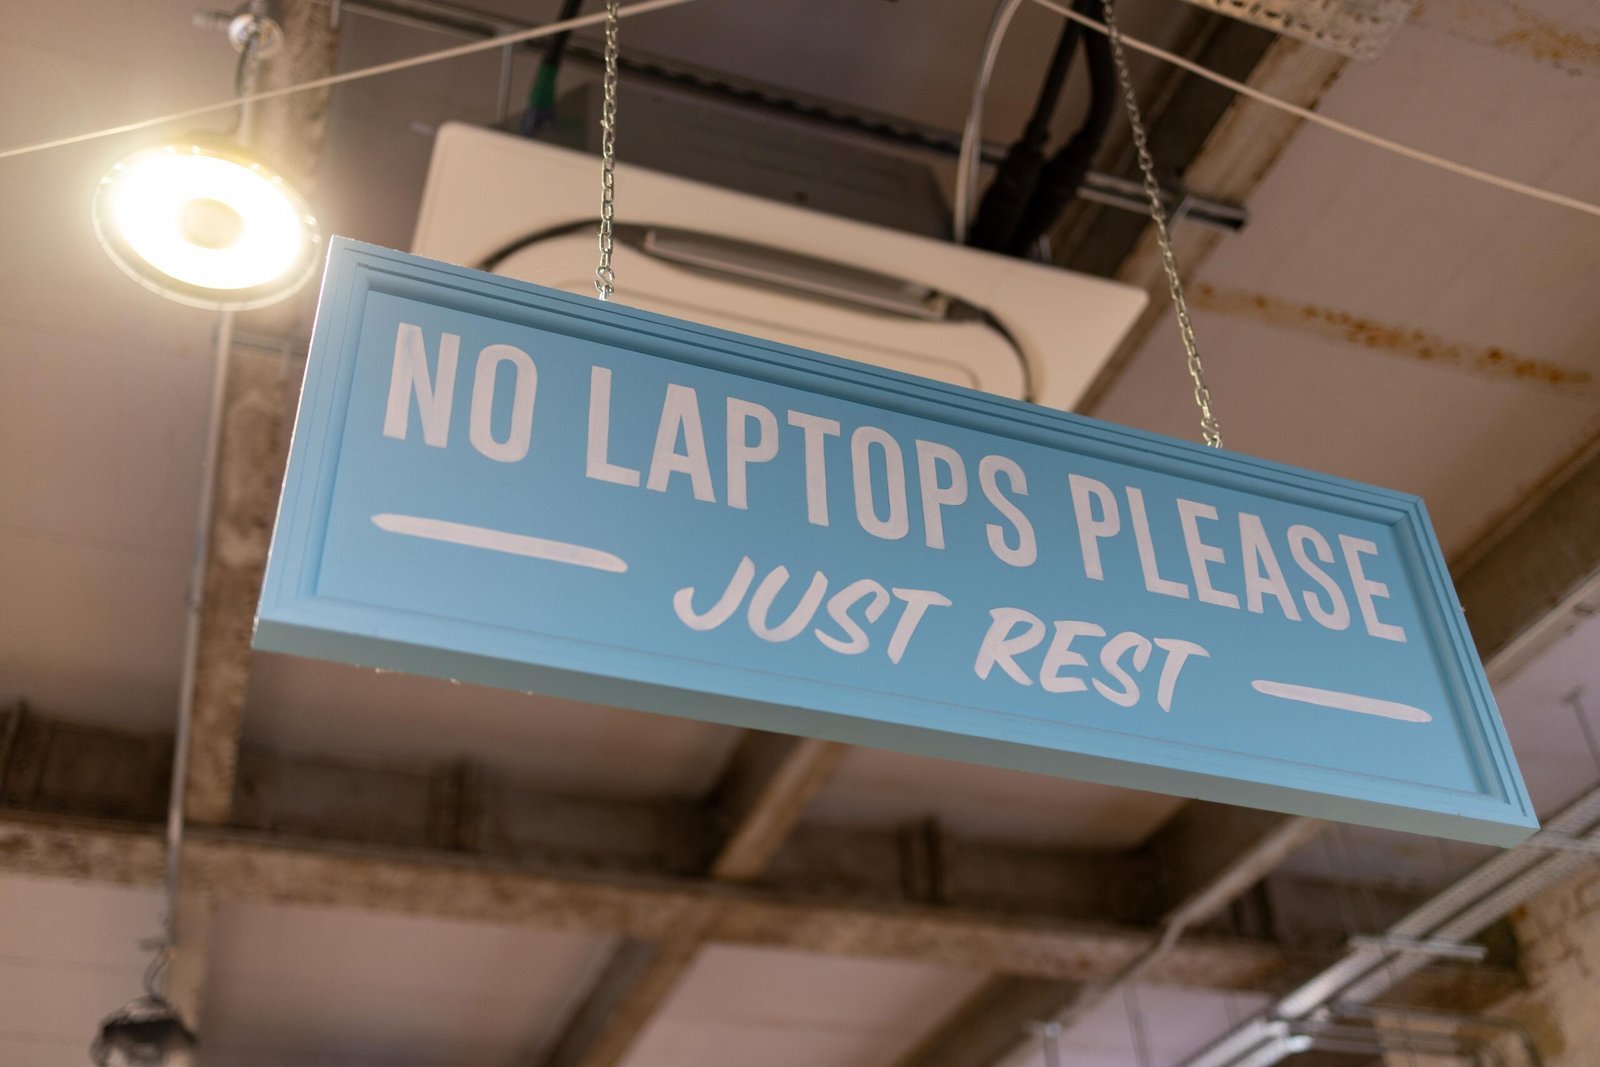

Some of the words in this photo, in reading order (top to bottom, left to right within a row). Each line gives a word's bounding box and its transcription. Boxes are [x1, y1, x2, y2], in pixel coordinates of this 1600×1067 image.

[383, 322, 538, 464] NO
[585, 365, 1037, 568] LAPTOPS
[1068, 473, 1407, 644] PLEASE
[673, 556, 952, 665] JUST
[975, 608, 1210, 712] REST
